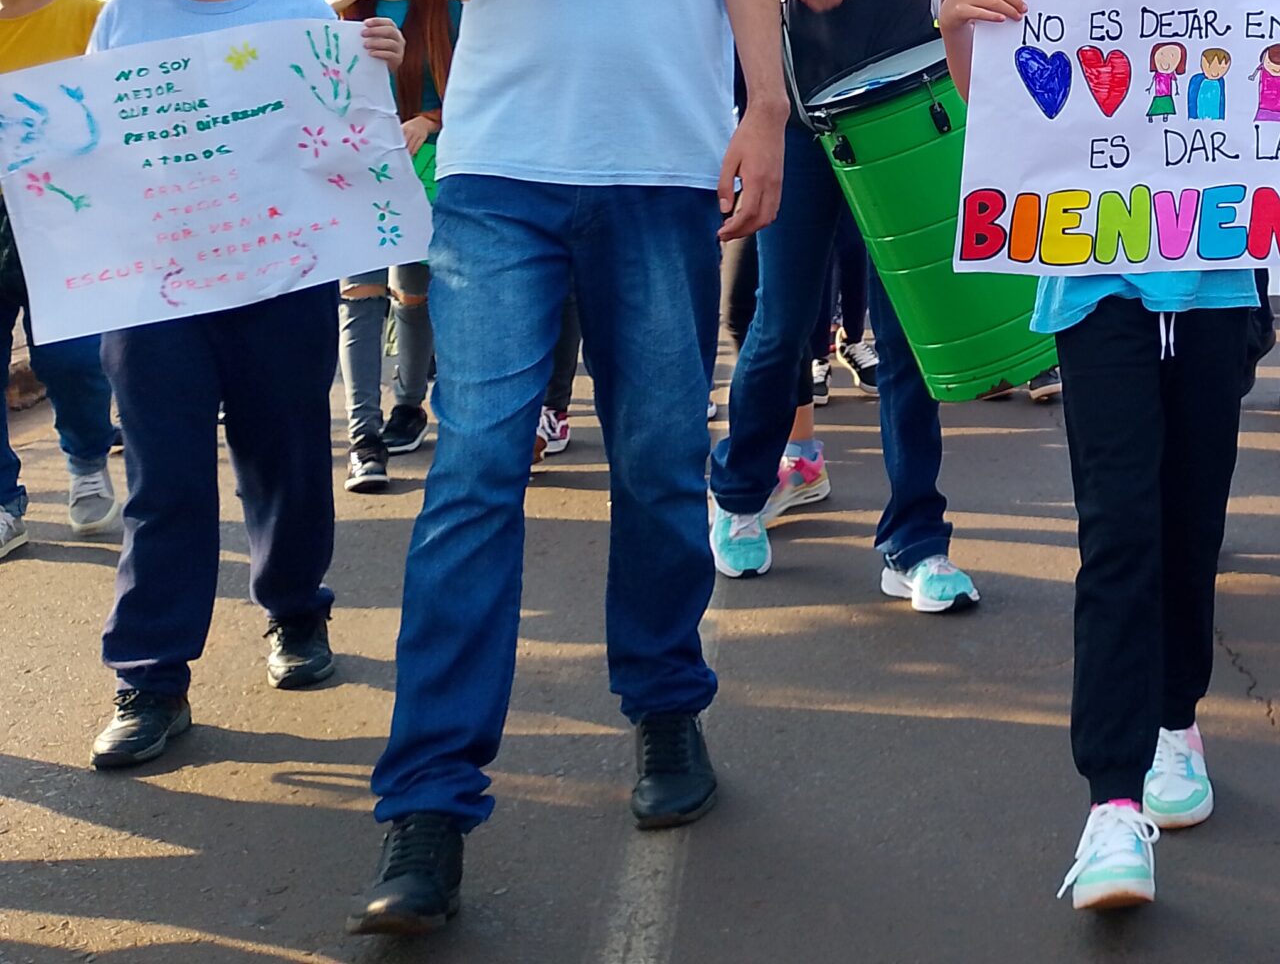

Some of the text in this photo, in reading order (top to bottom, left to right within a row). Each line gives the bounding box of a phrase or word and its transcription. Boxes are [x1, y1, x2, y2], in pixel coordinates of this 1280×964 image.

[1022, 12, 1065, 44] NO
[1090, 10, 1123, 41] ES
[1140, 7, 1231, 40] DEJAR
[114, 57, 191, 82] NO SOY
[113, 82, 183, 103] MEJOR
[118, 106, 149, 120] QUE
[1090, 134, 1130, 169] ES
[1164, 129, 1239, 167] DAR
